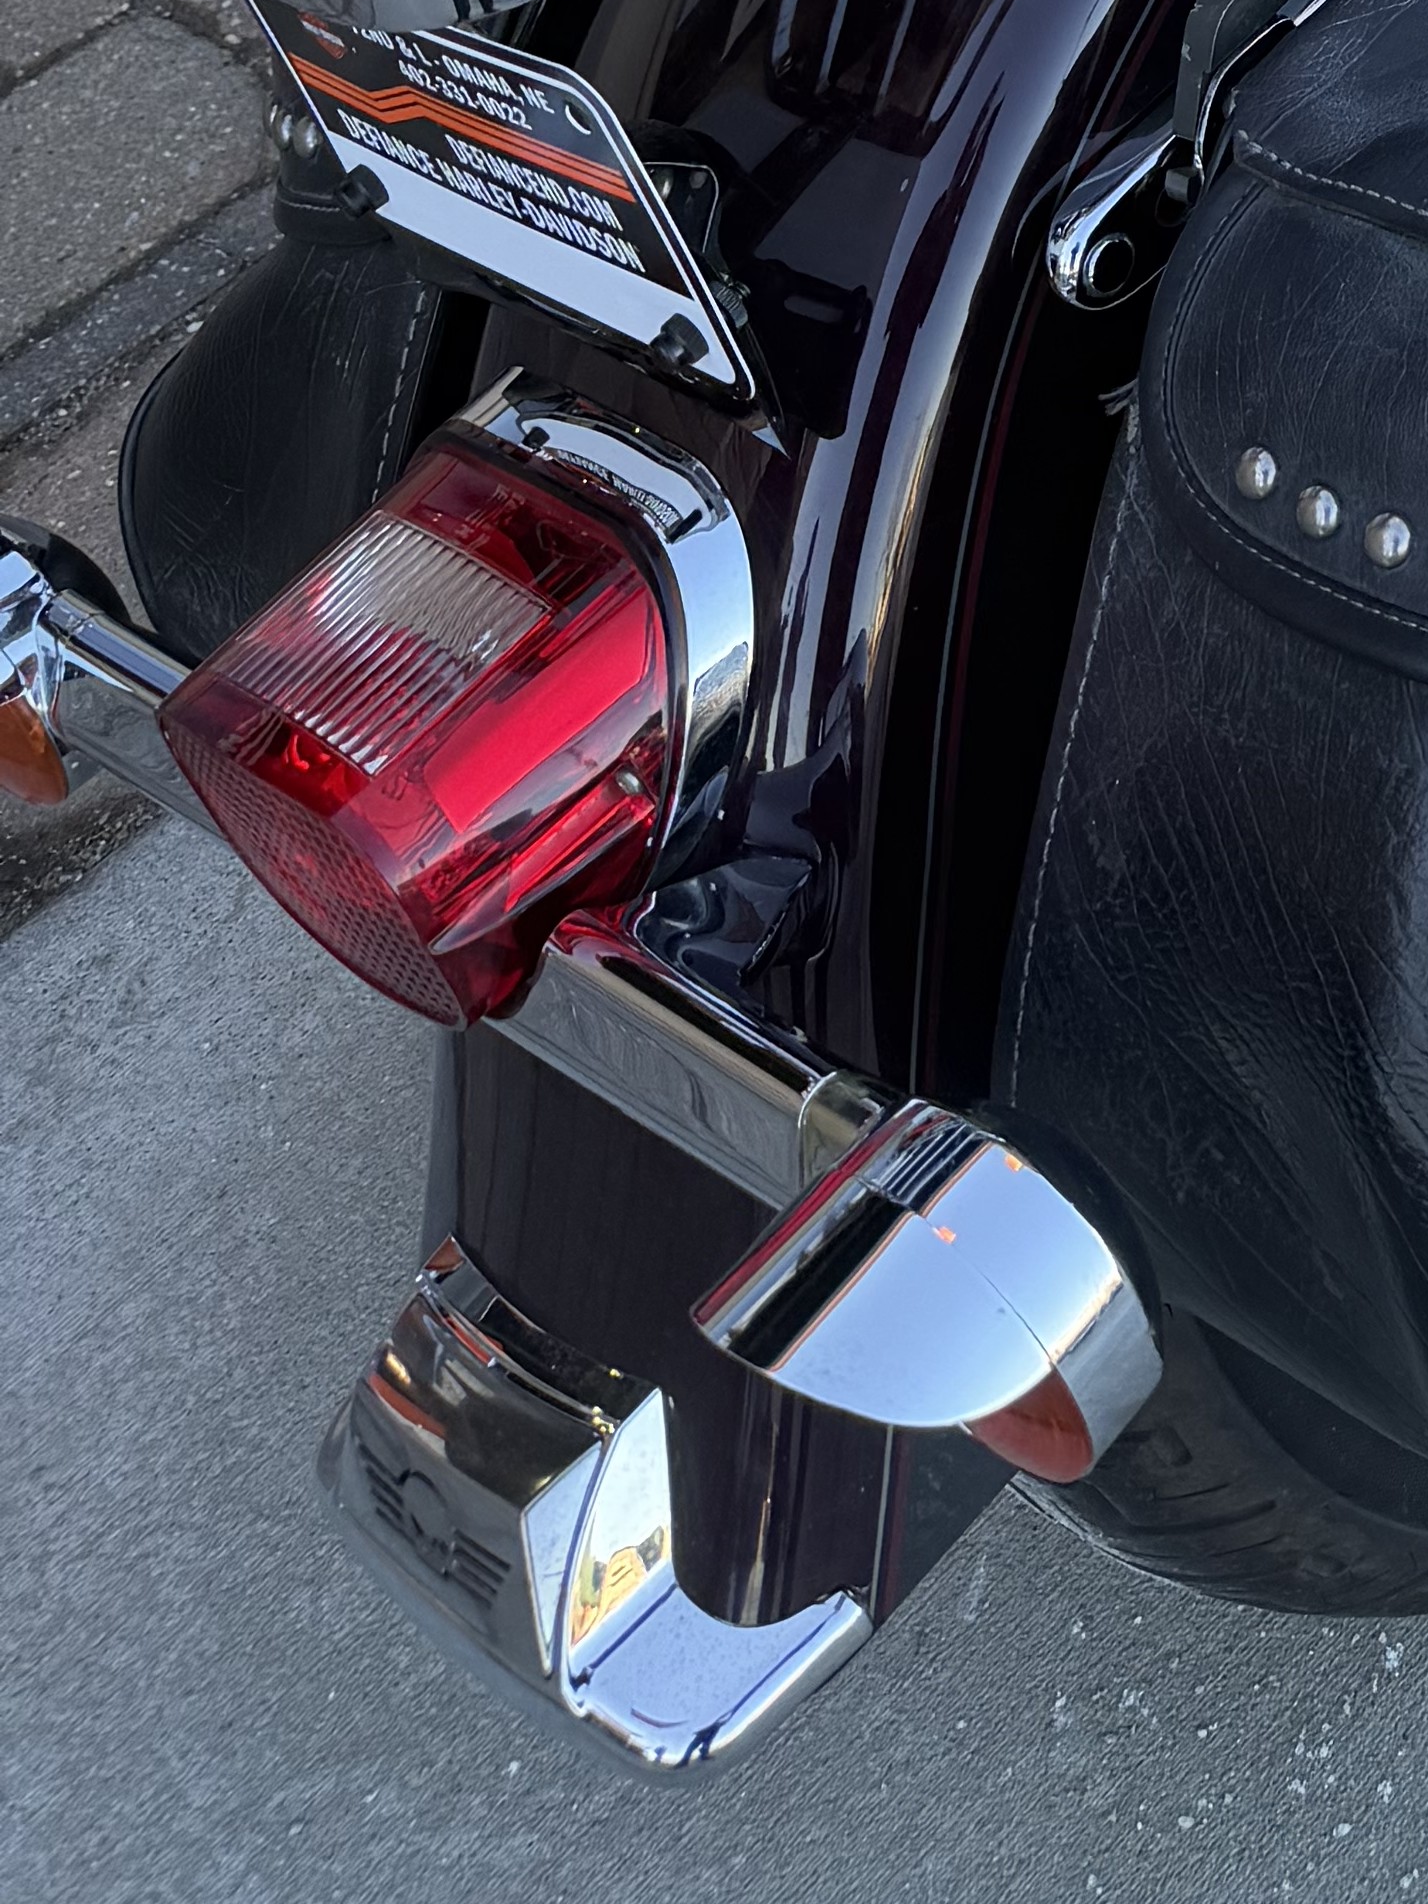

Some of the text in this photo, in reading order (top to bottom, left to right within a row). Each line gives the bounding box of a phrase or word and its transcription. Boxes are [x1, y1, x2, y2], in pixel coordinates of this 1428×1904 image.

[352, 26, 394, 50] 2ND
[395, 35, 416, 61] &
[413, 42, 432, 67] L
[442, 54, 524, 106] OMAHA,
[521, 84, 555, 114] NE
[398, 59, 533, 130] 402-331-0022
[337, 108, 646, 273] DEFIANCE HARLEY-DAVIDSON
[445, 133, 623, 232] DEFIANCEHD.COM
